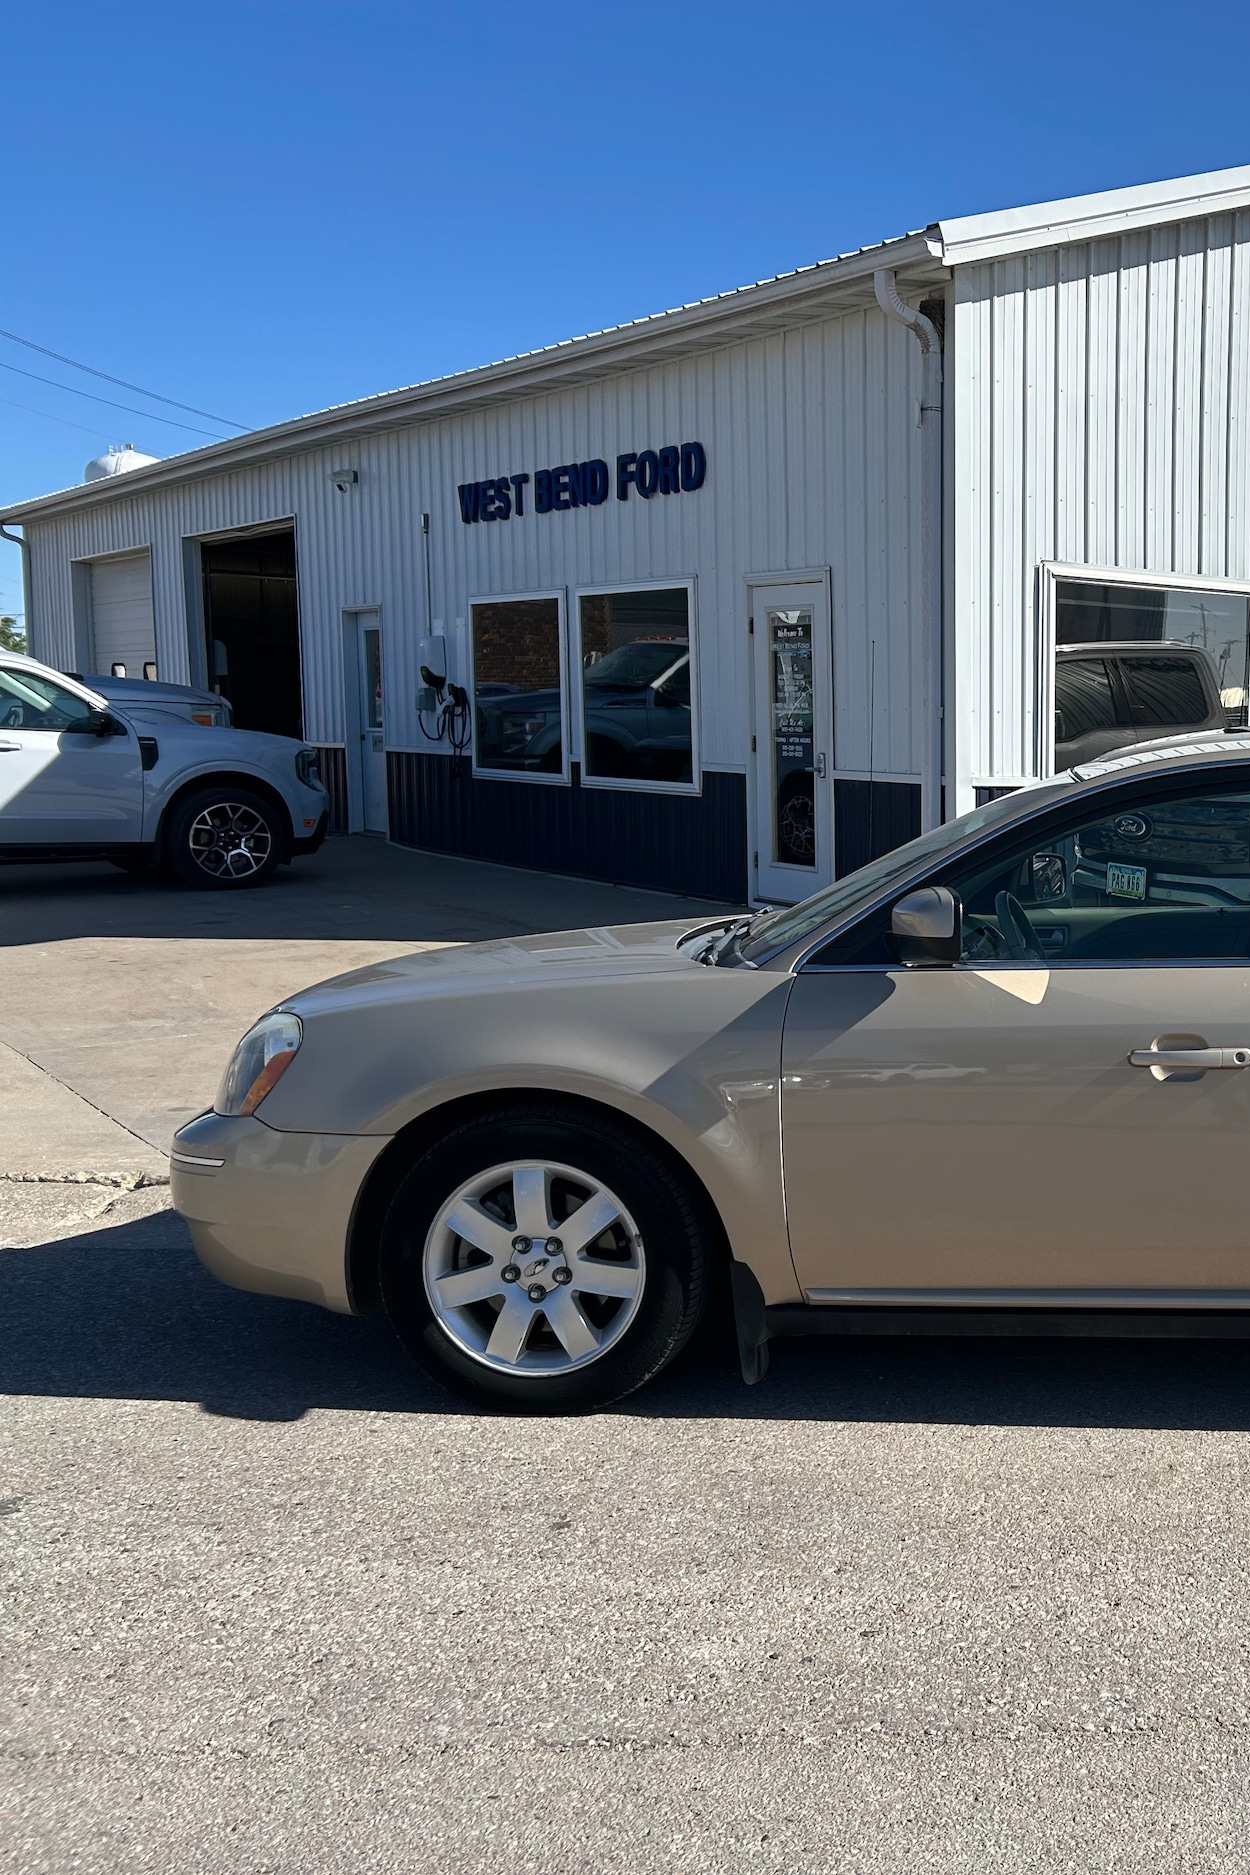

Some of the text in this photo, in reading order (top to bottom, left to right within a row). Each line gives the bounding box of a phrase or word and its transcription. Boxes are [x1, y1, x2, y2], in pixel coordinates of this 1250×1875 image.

[458, 441, 706, 524] WEST BEND FORD
[1120, 819, 1138, 832] Ford
